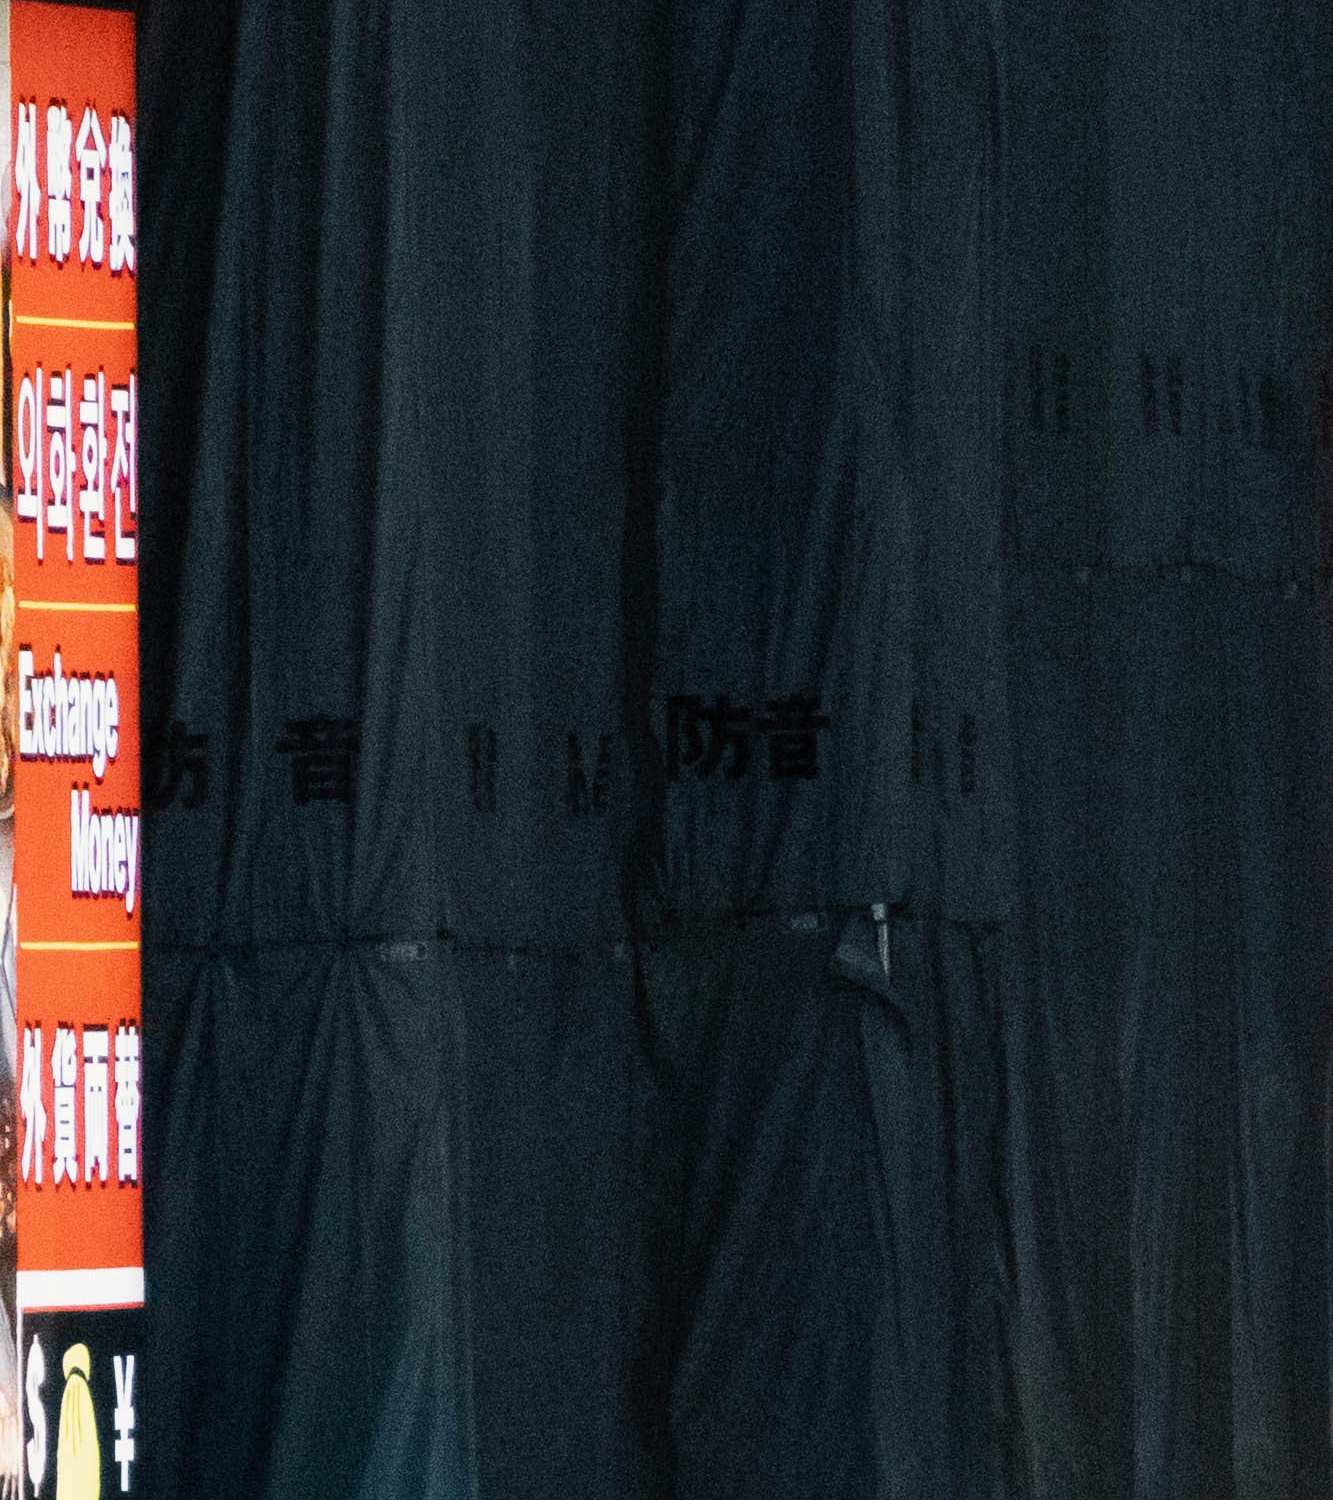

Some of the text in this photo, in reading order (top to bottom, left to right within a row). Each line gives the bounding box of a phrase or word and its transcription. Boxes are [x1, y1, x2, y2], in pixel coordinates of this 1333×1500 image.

[17, 366, 137, 562] 외화환전
[18, 648, 119, 780] Exchange
[71, 788, 139, 914] Money
